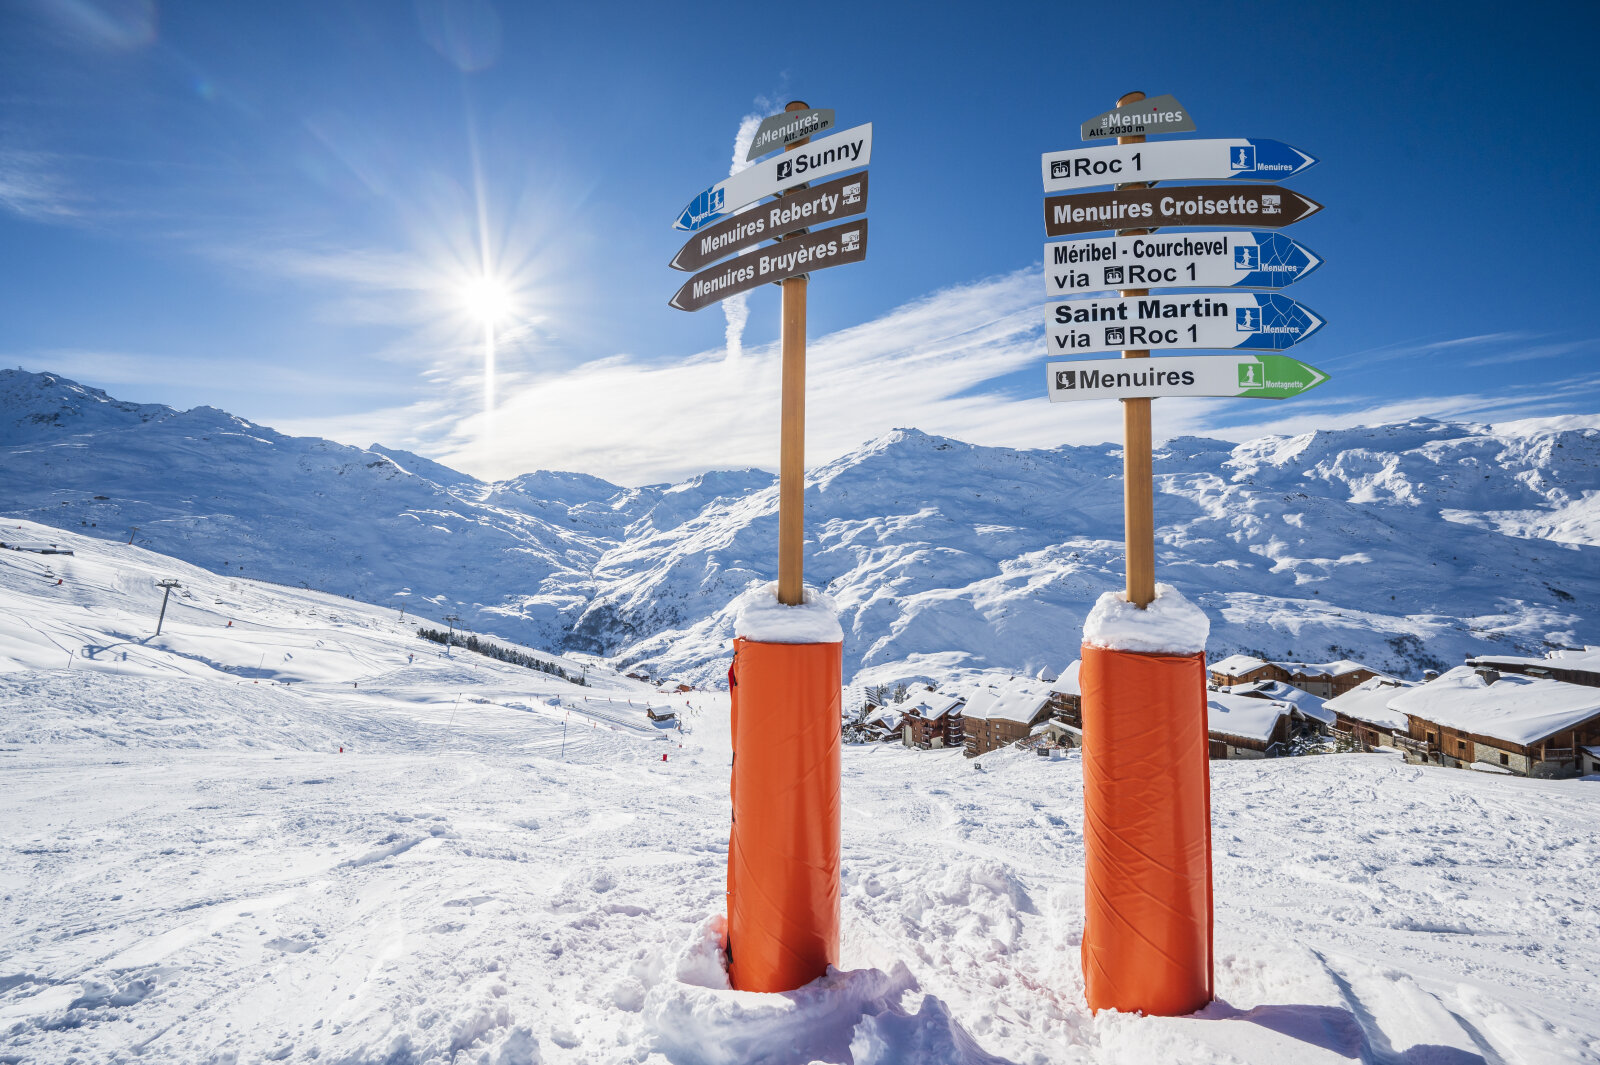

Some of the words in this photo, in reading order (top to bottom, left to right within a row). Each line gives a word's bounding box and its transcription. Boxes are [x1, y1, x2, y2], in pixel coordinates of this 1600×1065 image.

[761, 113, 819, 146] Menuires
[1109, 107, 1183, 127] Menuires
[783, 133, 798, 143] Alt.
[800, 123, 819, 136] 2030
[820, 120, 829, 128] m
[1089, 128, 1106, 137] Alt.
[1109, 125, 1133, 135] 2030
[795, 139, 864, 174] Sunny
[1074, 157, 1123, 177] Roc
[1131, 152, 1142, 171] 1
[1257, 162, 1293, 172] Menuires
[1053, 200, 1153, 225] Menuires
[1159, 195, 1259, 216] Croisette
[701, 217, 765, 256] Menuires
[769, 193, 839, 228] Reberty
[1054, 241, 1117, 265] Méribel
[1133, 237, 1228, 259] Courchevel
[693, 264, 755, 300] Menuires
[759, 240, 838, 276] Bruyères
[1054, 270, 1090, 289] via
[1128, 265, 1177, 284] Roc
[1185, 262, 1197, 281] 1
[1261, 263, 1298, 272] Menuires
[1055, 302, 1128, 324] Saint
[1138, 298, 1229, 320] Martin
[1055, 330, 1091, 349] via
[1129, 326, 1178, 345] Roc
[1187, 323, 1198, 343] 1
[1263, 325, 1299, 334] Menuires
[1079, 367, 1195, 389] Menuires
[1265, 380, 1304, 390] Montagnette
